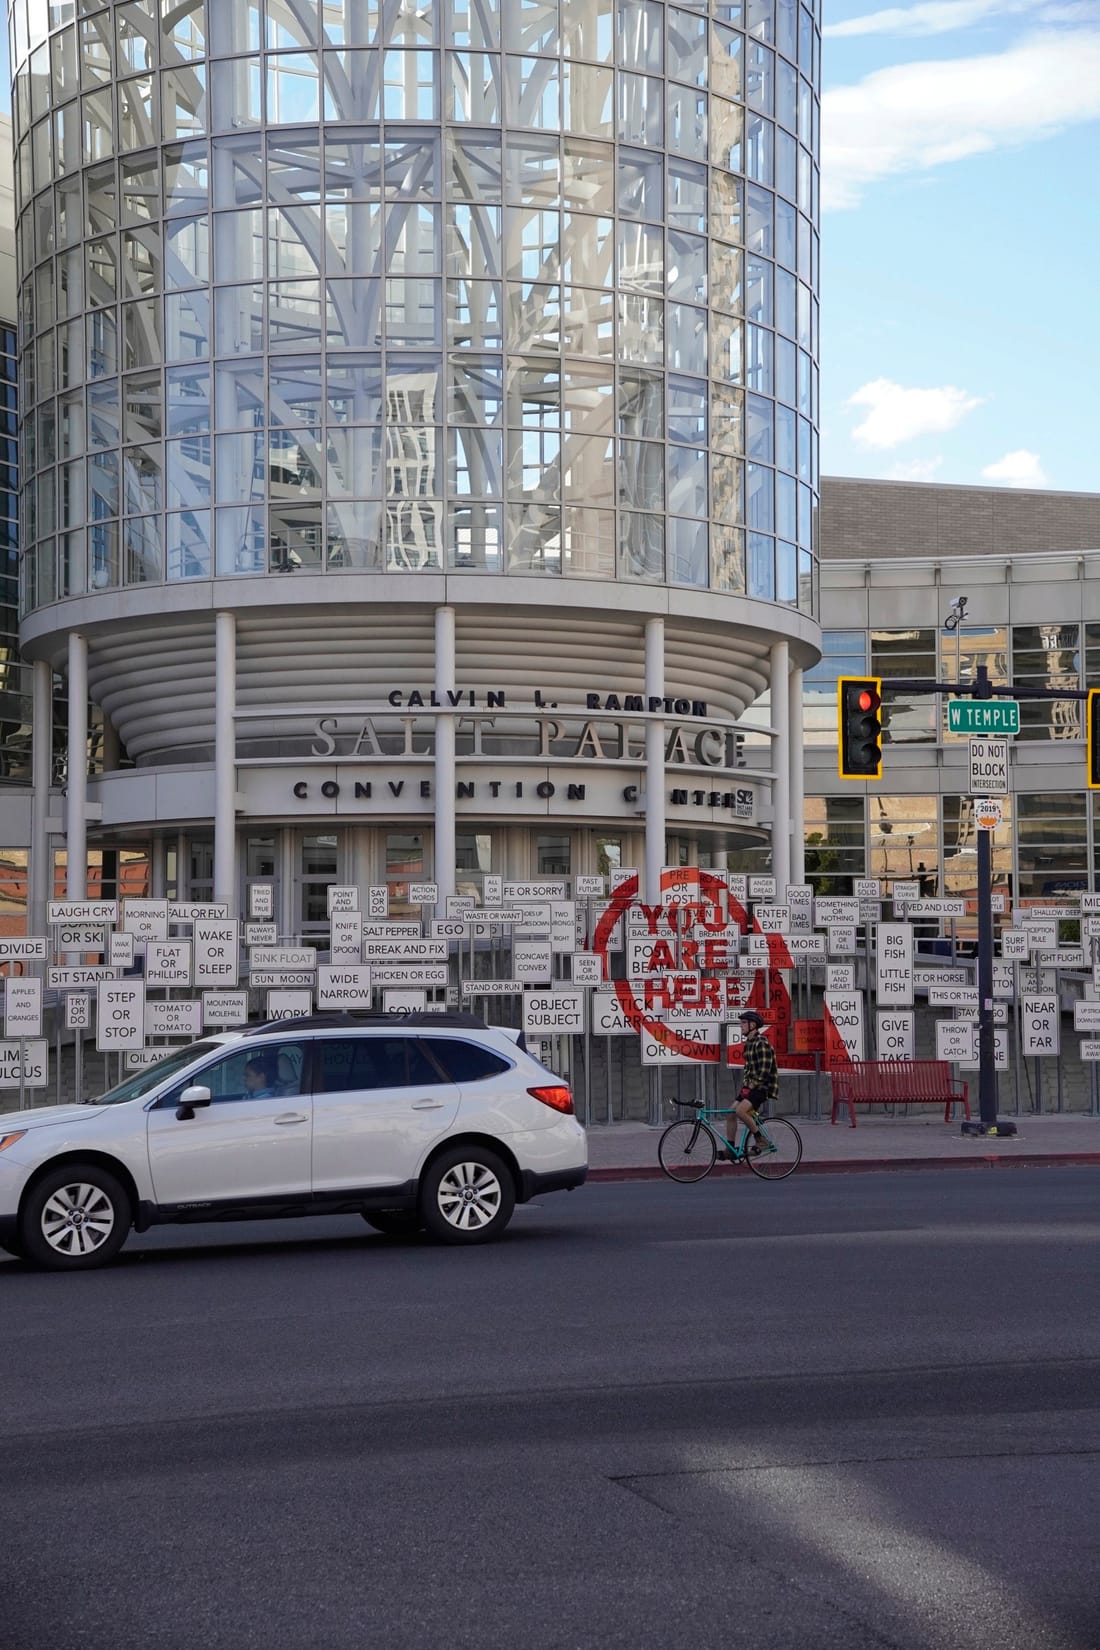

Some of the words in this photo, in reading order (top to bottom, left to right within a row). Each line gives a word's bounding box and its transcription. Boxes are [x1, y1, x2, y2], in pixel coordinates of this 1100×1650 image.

[388, 690, 505, 708] CALVIN
[534, 690, 558, 708] L.
[586, 693, 707, 717] RAMPTON
[951, 708, 961, 726] W
[967, 708, 1017, 727] TEMPLE
[311, 717, 496, 757] SALT
[535, 719, 746, 768] PALACE
[972, 744, 984, 758] DO
[987, 744, 1005, 758] NOT
[972, 763, 1005, 777] BLOCK
[972, 779, 1006, 789] INTERSECTION
[293, 780, 585, 801] CONVENTION
[623, 785, 735, 808] CNTER
[517, 887, 531, 896] OR
[532, 887, 563, 896] SORRY
[579, 885, 602, 893] FUTURE
[671, 883, 688, 892] OR
[371, 889, 386, 897] SAY
[787, 890, 810, 899] GOOD
[372, 898, 385, 906] OR
[665, 894, 695, 905] POST
[52, 907, 90, 917] LAUGH
[93, 907, 114, 917] CRY
[372, 906, 385, 914] DO
[924, 903, 942, 912] AND
[943, 903, 962, 912] LOST
[125, 911, 165, 919] MORNING
[190, 908, 206, 918] OR
[208, 909, 225, 918] FLY
[756, 909, 788, 918] ENTER
[639, 901, 729, 936] YOU
[139, 923, 152, 931] OR
[335, 922, 358, 930] KNIFE
[437, 925, 464, 935] EGO
[762, 921, 783, 930] EXIT
[199, 931, 233, 941] WAKE
[363, 927, 382, 937] SALT
[385, 927, 418, 937] PEPPER
[832, 929, 852, 937] STAND
[61, 932, 82, 943] OR
[84, 932, 104, 943] SKI
[886, 936, 903, 945] BIG
[1005, 937, 1025, 945] SURF
[754, 940, 776, 949] LESS
[791, 940, 820, 949] MORE
[1006, 945, 1025, 953] TURF
[156, 948, 181, 958] FLAT
[207, 948, 225, 958] OR
[333, 946, 360, 954] SPOON
[368, 945, 401, 954] BREAK
[404, 945, 426, 954] AND
[429, 945, 445, 954] FIX
[634, 945, 669, 958] POST
[254, 954, 278, 963] SINK
[280, 954, 313, 963] FLOAT
[515, 953, 550, 961] CONCAVE
[647, 939, 728, 971] ARE
[884, 950, 906, 959] FISH
[1057, 954, 1083, 962] FLIGHT
[161, 959, 176, 969] OR
[579, 959, 596, 967] SEEN
[747, 957, 762, 966] BEE
[199, 964, 233, 975] SLEEP
[518, 964, 547, 972] CONVEX
[52, 973, 70, 983] SIT
[73, 972, 114, 983] STAND
[148, 970, 189, 979] PHILLIPS
[410, 971, 423, 980] OR
[425, 971, 445, 980] EGG
[576, 974, 599, 982] HEARD
[880, 969, 910, 979] LITTLE
[922, 974, 935, 982] OR
[936, 974, 964, 983] HORSE
[255, 975, 274, 984] SUN
[280, 975, 311, 984] MOON
[330, 974, 359, 984] WIDE
[465, 984, 491, 992] STAND
[491, 984, 506, 992] OR
[505, 984, 520, 992] RUN
[830, 982, 851, 990] HEART
[884, 983, 906, 993] FISH
[107, 992, 136, 1003] STEP
[320, 989, 369, 999] NARROW
[644, 977, 740, 1009] HERE
[932, 992, 949, 1000] THIS
[949, 992, 961, 1000] OR
[70, 999, 86, 1007] TRY
[206, 999, 244, 1007] MOUNTAIN
[530, 999, 578, 1011] OBJECT
[610, 998, 654, 1012] STICK
[830, 1001, 857, 1011] HIGH
[1025, 1002, 1055, 1013] NEAR
[70, 1007, 85, 1015] OR
[153, 1004, 193, 1013] TOMATO
[671, 1008, 692, 1017] ONE
[695, 1009, 723, 1017] MANY
[112, 1009, 130, 1020] OR
[166, 1014, 180, 1022] OR
[70, 1016, 86, 1024] DO
[527, 1015, 581, 1026] SUBJECT
[830, 1016, 859, 1026] ROAD
[1032, 1019, 1050, 1030] OR
[153, 1023, 192, 1032] TOMATO
[881, 1020, 909, 1031] GIVE
[941, 1026, 968, 1034] THROW
[105, 1027, 136, 1038] STOP
[675, 1029, 708, 1041] BEAT
[832, 1040, 857, 1050] LOW
[887, 1036, 904, 1048] OR
[1030, 1036, 1052, 1047] FAR
[646, 1044, 666, 1057] OR
[670, 1044, 716, 1056] DOWN
[881, 1053, 910, 1062] TAKE
